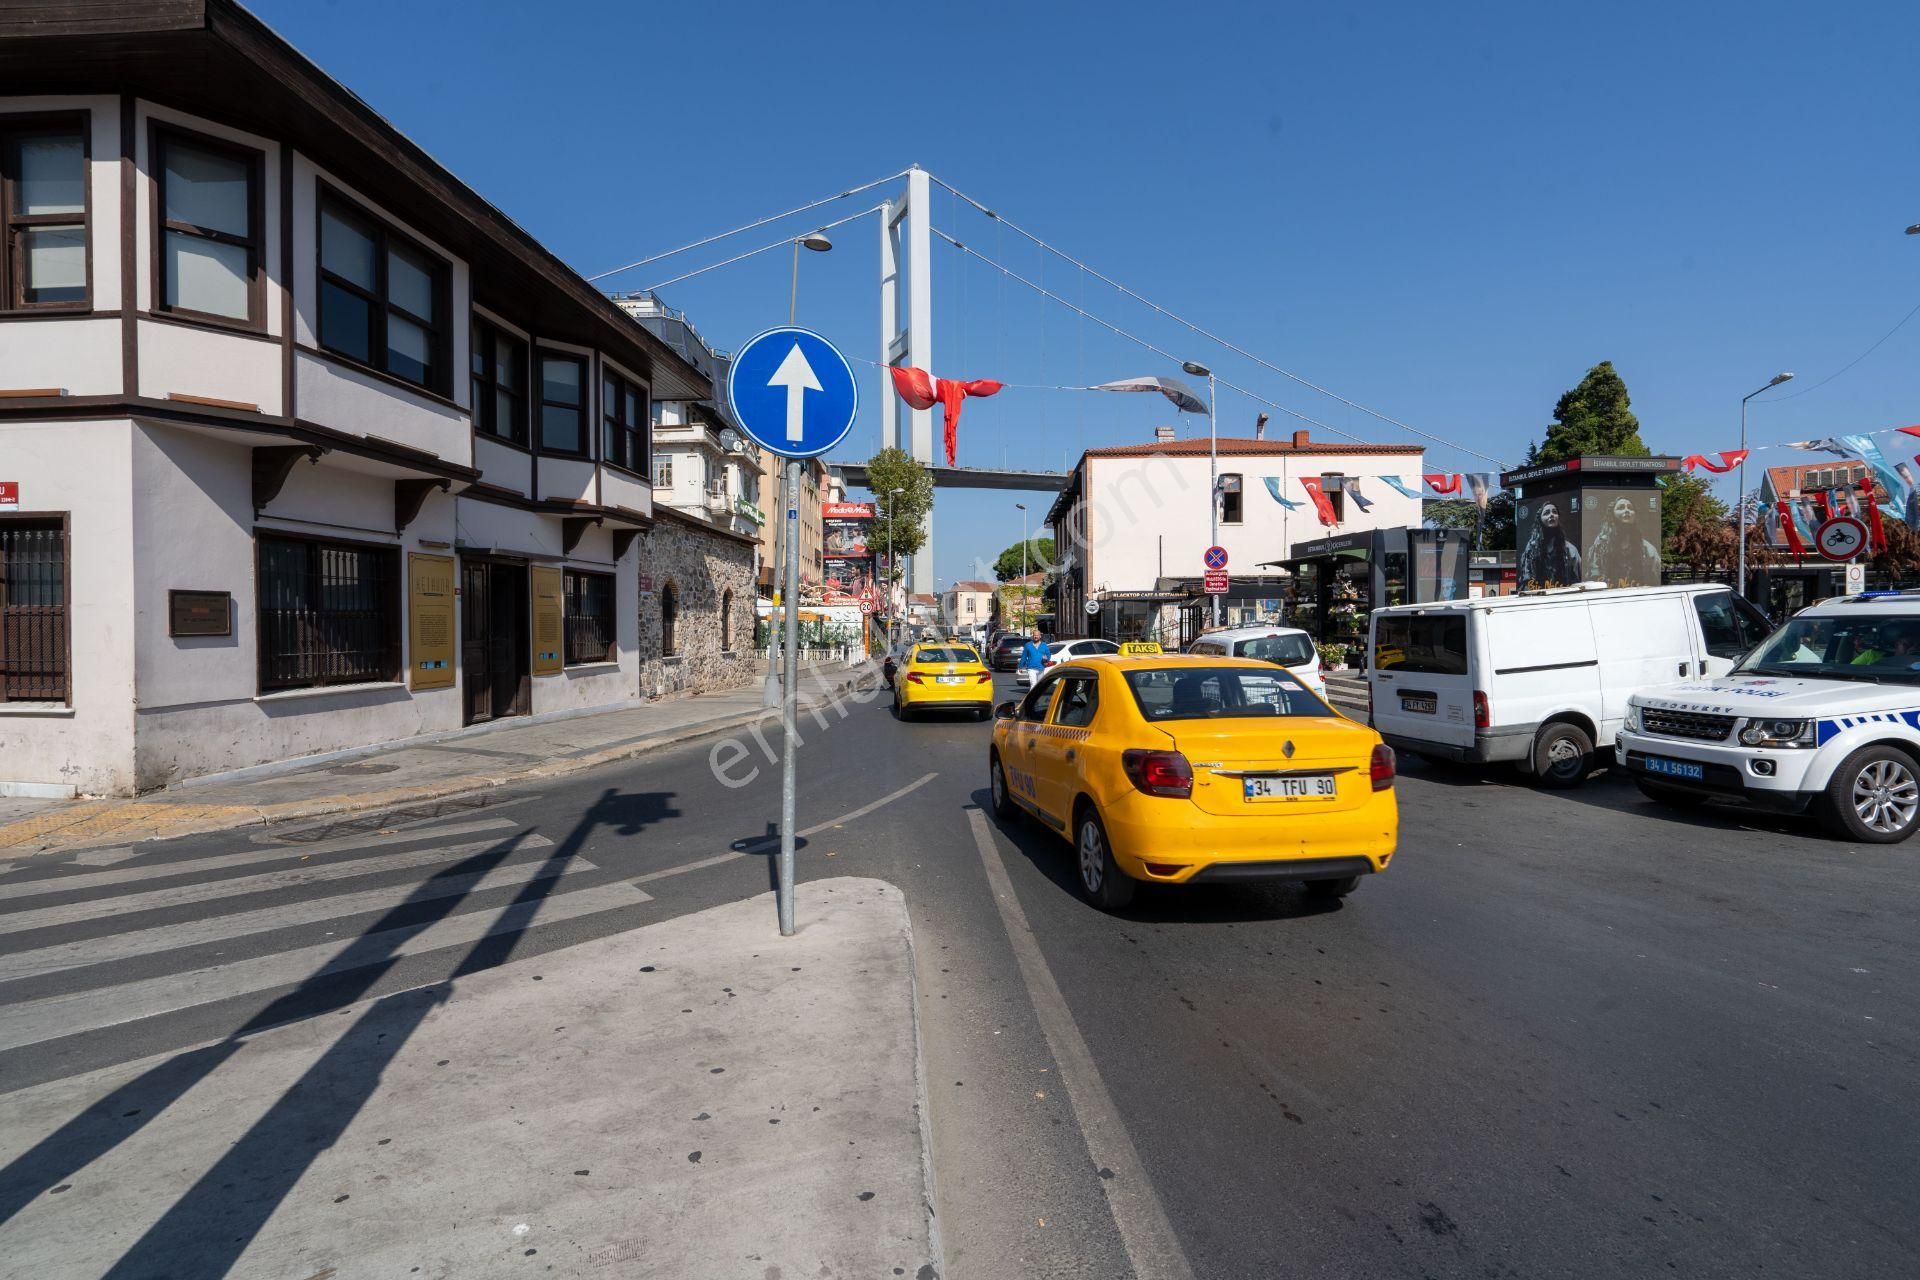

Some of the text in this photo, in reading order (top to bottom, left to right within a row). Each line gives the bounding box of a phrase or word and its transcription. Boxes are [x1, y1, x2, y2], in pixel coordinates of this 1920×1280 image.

[1650, 758, 1700, 778] 34 A 56132
[1255, 779, 1333, 796] 34 TFU 90
